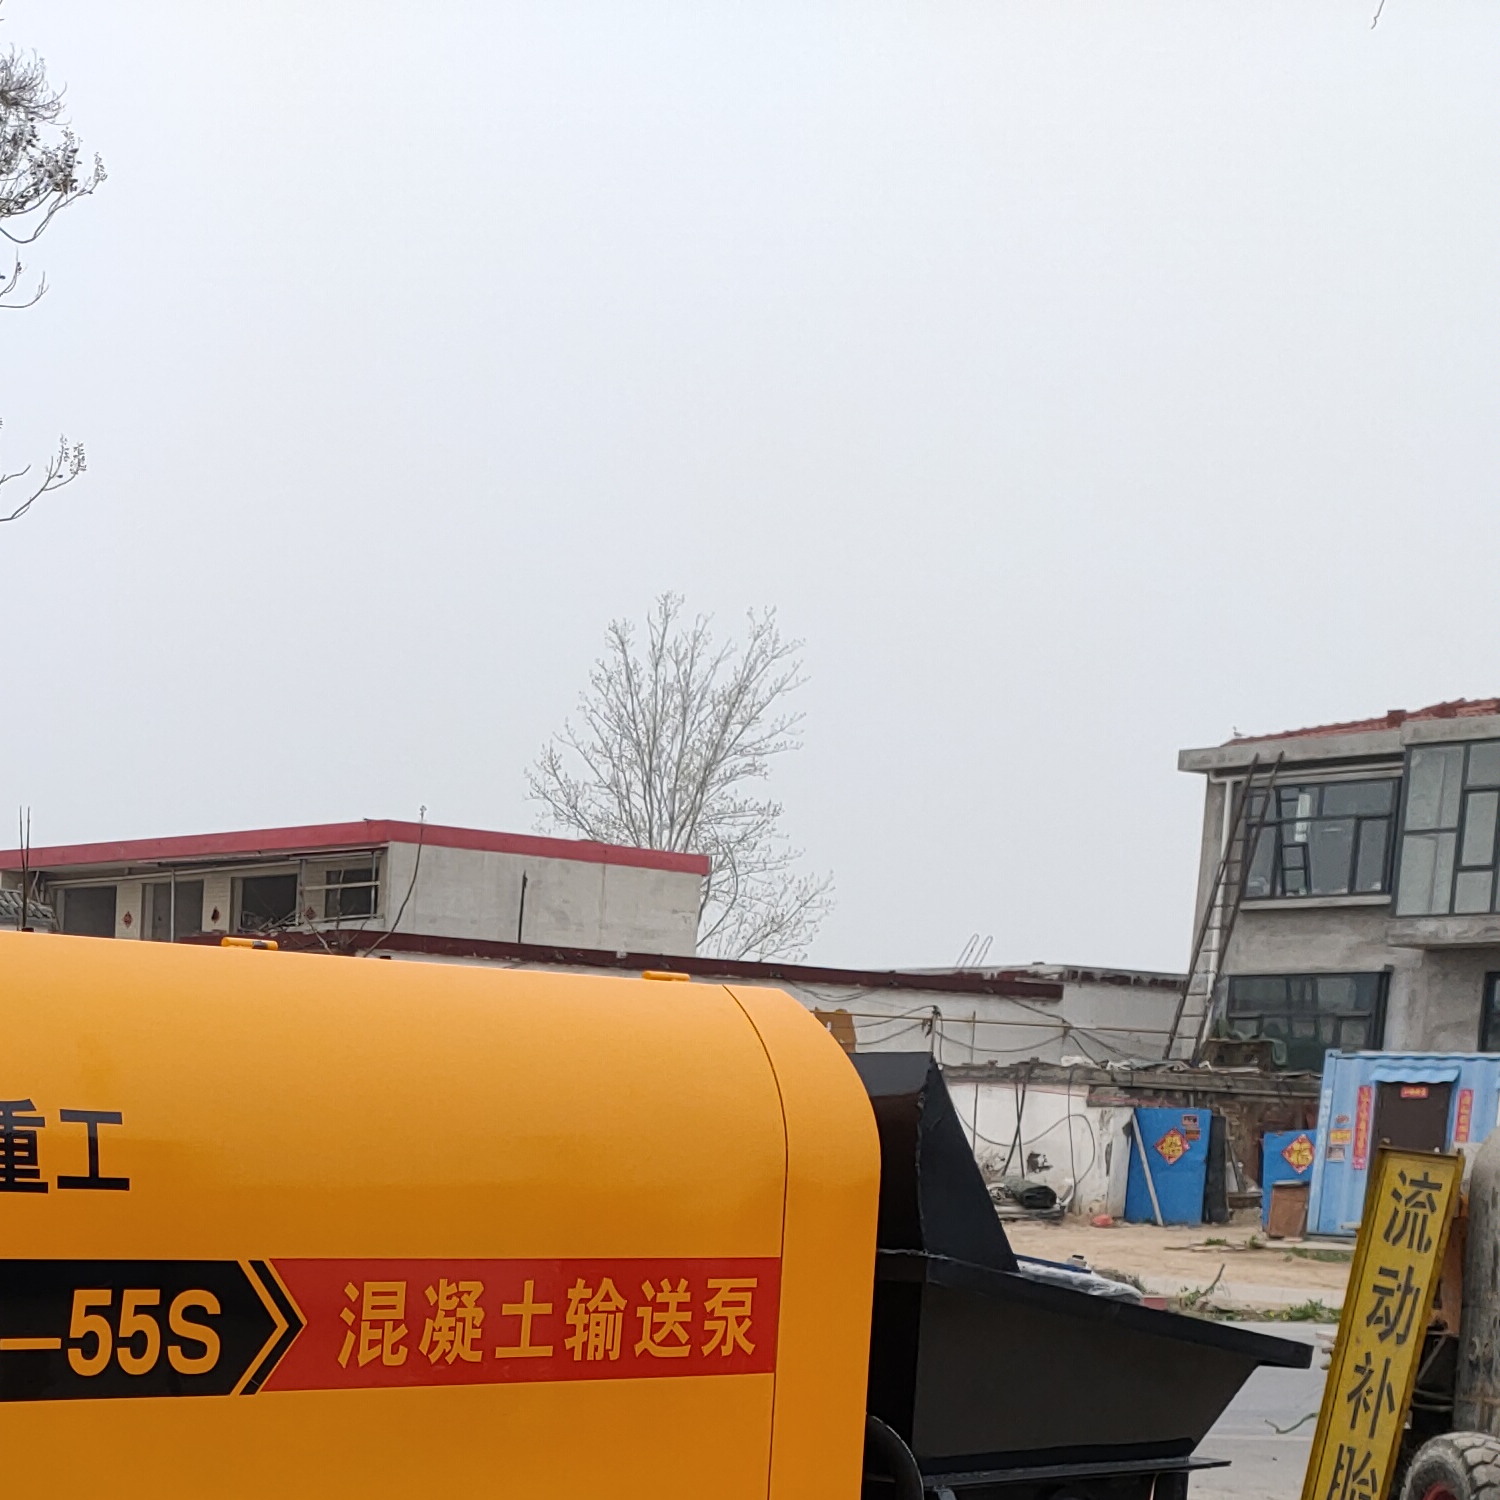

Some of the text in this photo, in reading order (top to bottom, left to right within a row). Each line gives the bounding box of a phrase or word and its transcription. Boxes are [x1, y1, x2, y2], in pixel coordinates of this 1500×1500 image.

[336, 1275, 760, 1368] 混凝土输送泵
